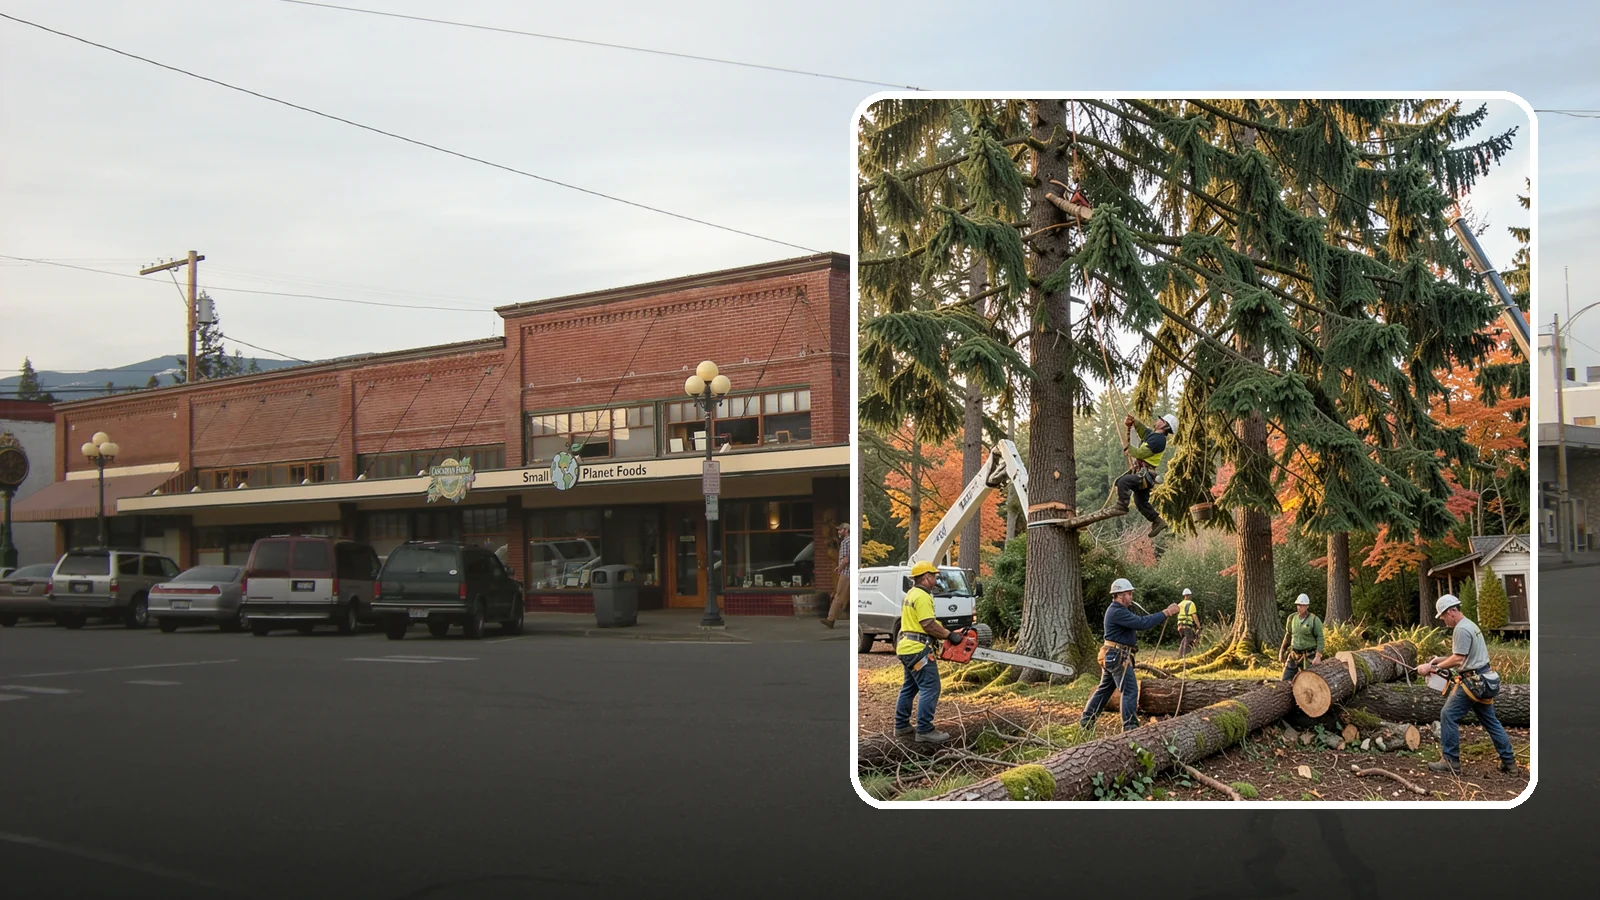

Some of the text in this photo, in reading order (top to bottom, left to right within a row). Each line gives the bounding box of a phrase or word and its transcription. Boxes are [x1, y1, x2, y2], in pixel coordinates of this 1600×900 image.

[455, 465, 470, 474] FARM
[523, 464, 647, 483] Small Planet Foods
